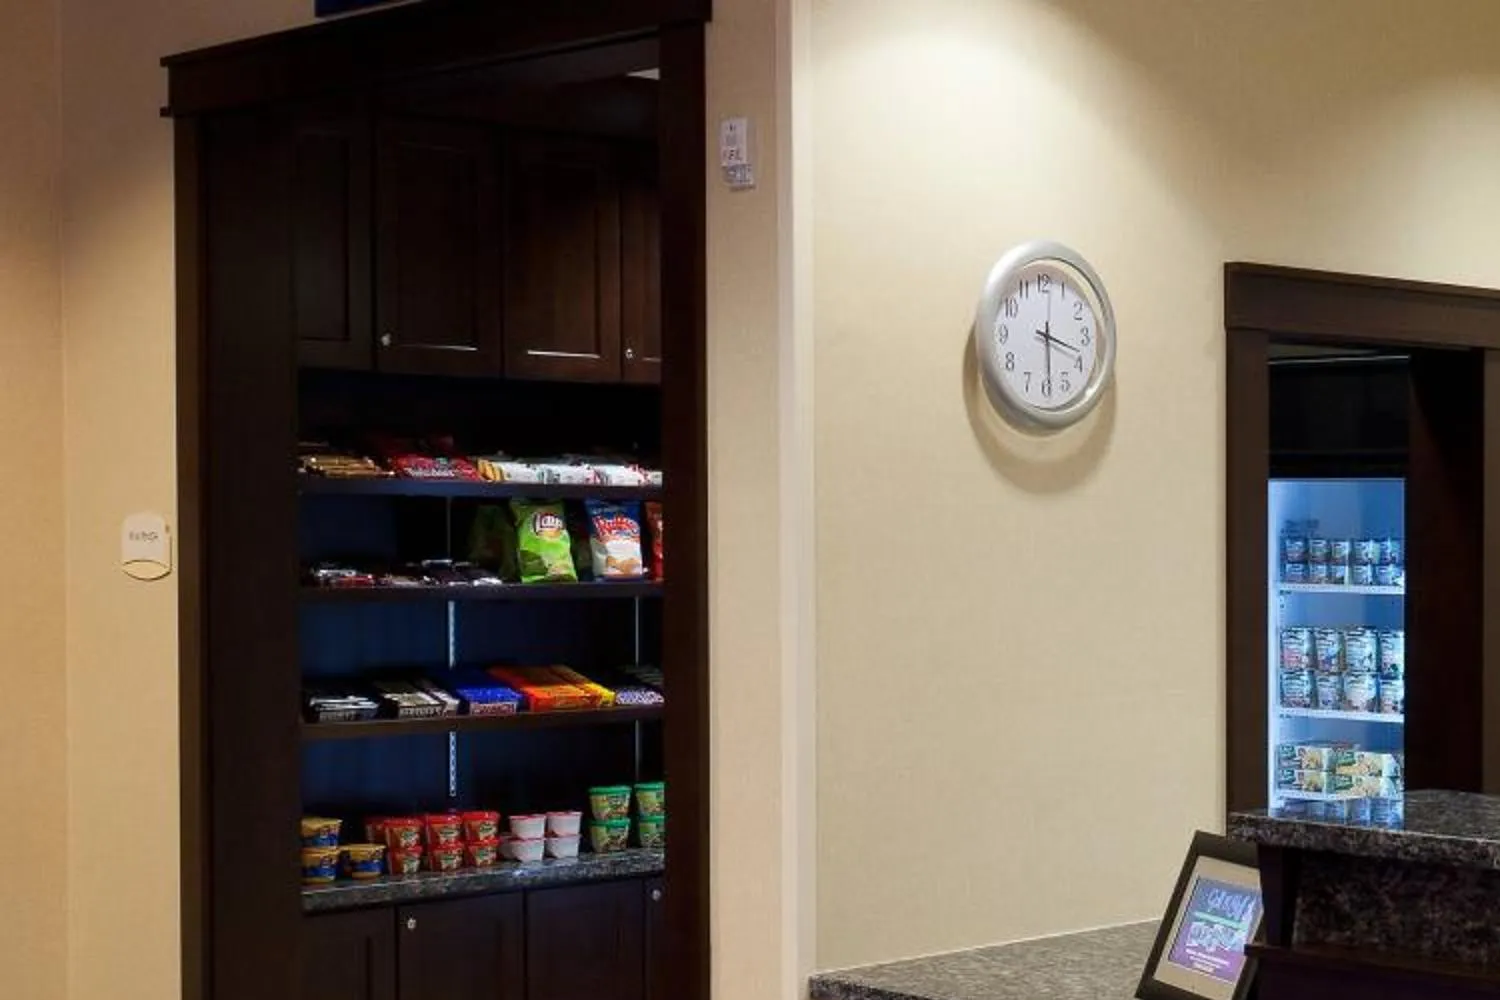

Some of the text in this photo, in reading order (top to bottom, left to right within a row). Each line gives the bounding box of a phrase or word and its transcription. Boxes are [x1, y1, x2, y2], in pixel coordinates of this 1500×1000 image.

[1019, 279, 1029, 299] 11
[1038, 273, 1051, 293] 12
[1005, 298, 1018, 318] 10
[1073, 302, 1083, 320] 2
[998, 325, 1008, 344] 9
[1080, 327, 1091, 345] 3
[1005, 352, 1015, 371] 8
[1074, 355, 1083, 373] 4
[1023, 371, 1032, 392] 7
[1041, 379, 1051, 397] 6
[1060, 372, 1071, 392] 5
